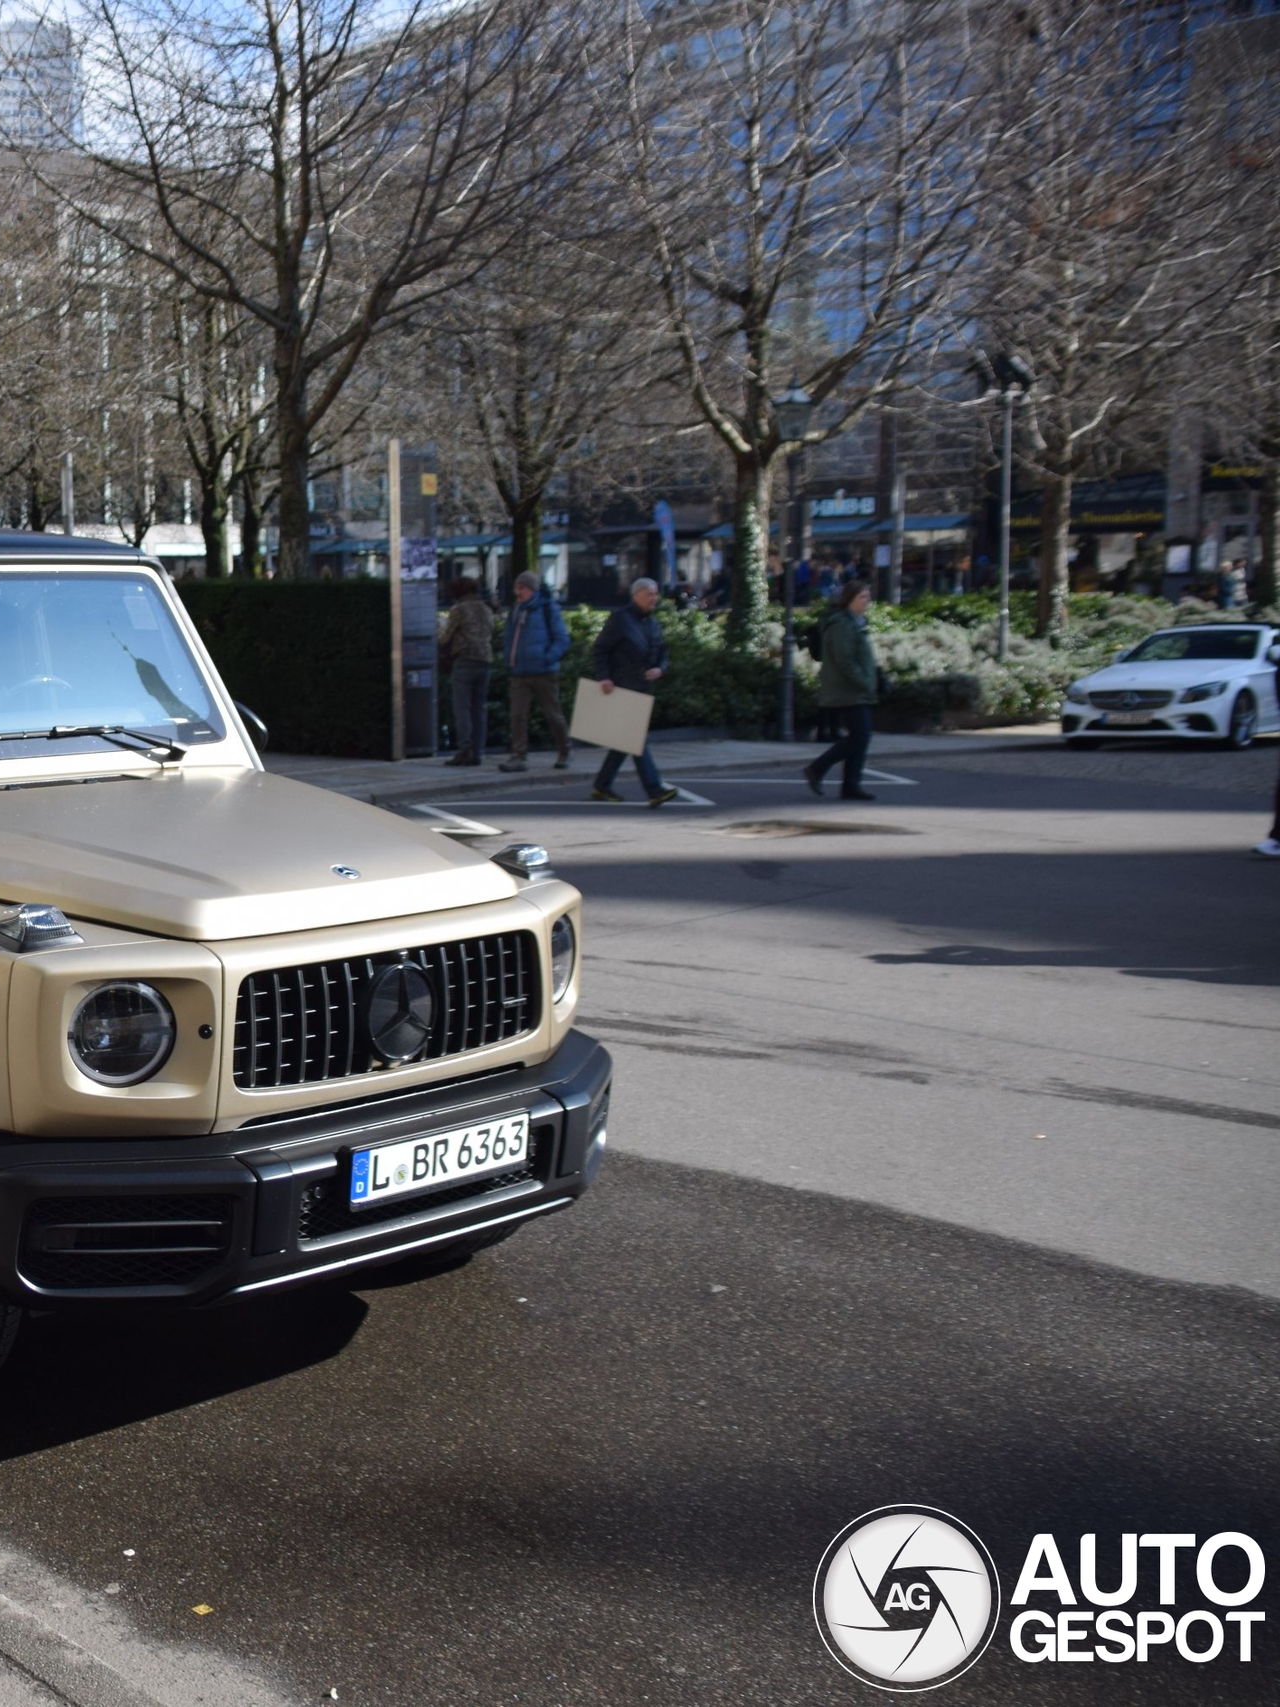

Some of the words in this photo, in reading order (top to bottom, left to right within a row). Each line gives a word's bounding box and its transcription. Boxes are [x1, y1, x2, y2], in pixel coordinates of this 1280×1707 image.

[371, 1154, 391, 1192] L
[411, 1138, 449, 1182] BR
[457, 1119, 525, 1170] 6363
[355, 1181, 364, 1193] D
